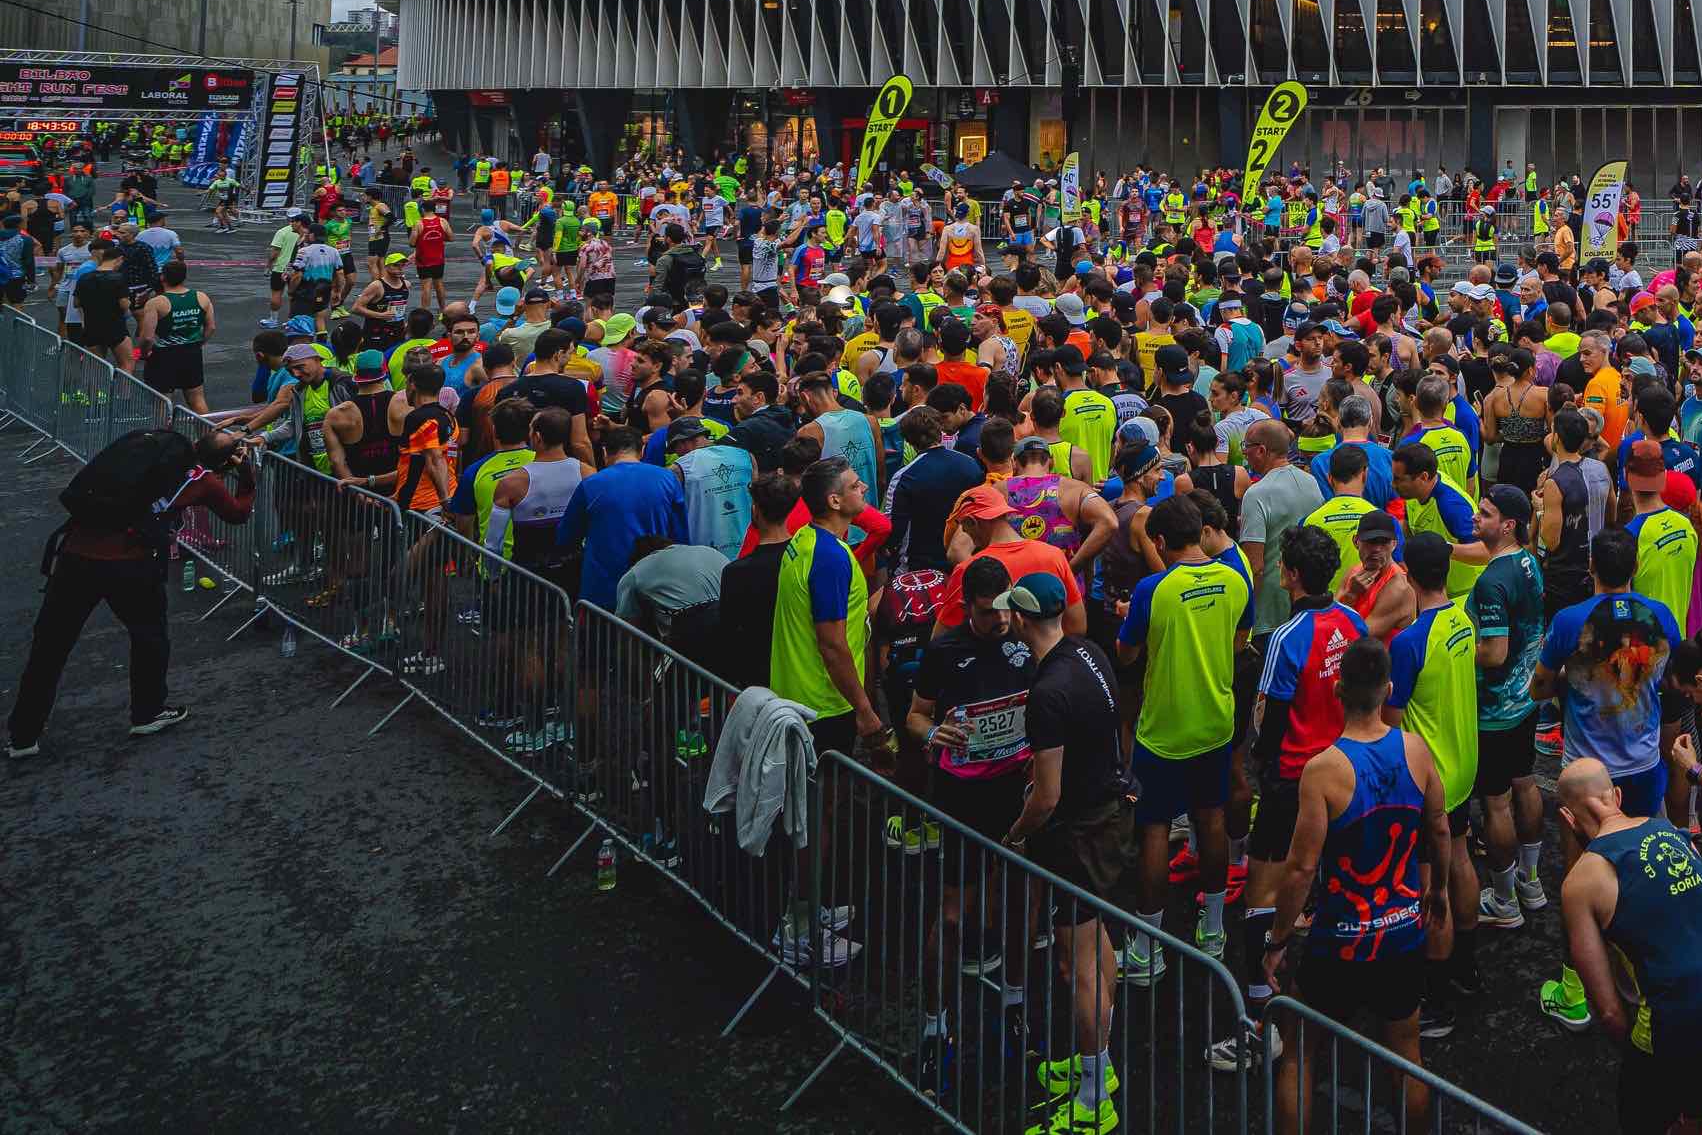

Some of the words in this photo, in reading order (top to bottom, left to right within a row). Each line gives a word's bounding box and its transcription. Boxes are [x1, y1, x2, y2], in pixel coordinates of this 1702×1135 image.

[20, 68, 91, 80] BILBAO
[40, 82, 76, 94] RUN
[82, 84, 128, 95] FEST
[1344, 87, 1374, 106] 26
[886, 89, 898, 114] 1
[983, 90, 991, 104] A
[1274, 95, 1293, 118] 2
[26, 122, 76, 131] 18:43:50
[868, 123, 895, 134] START
[1256, 127, 1287, 137] START
[866, 136, 877, 169] 1
[1250, 139, 1268, 173] 2
[1591, 193, 1616, 209] 55'
[172, 308, 200, 317] KAIKU
[979, 711, 1016, 735] 2527
[1669, 873, 1702, 895] SORIA
